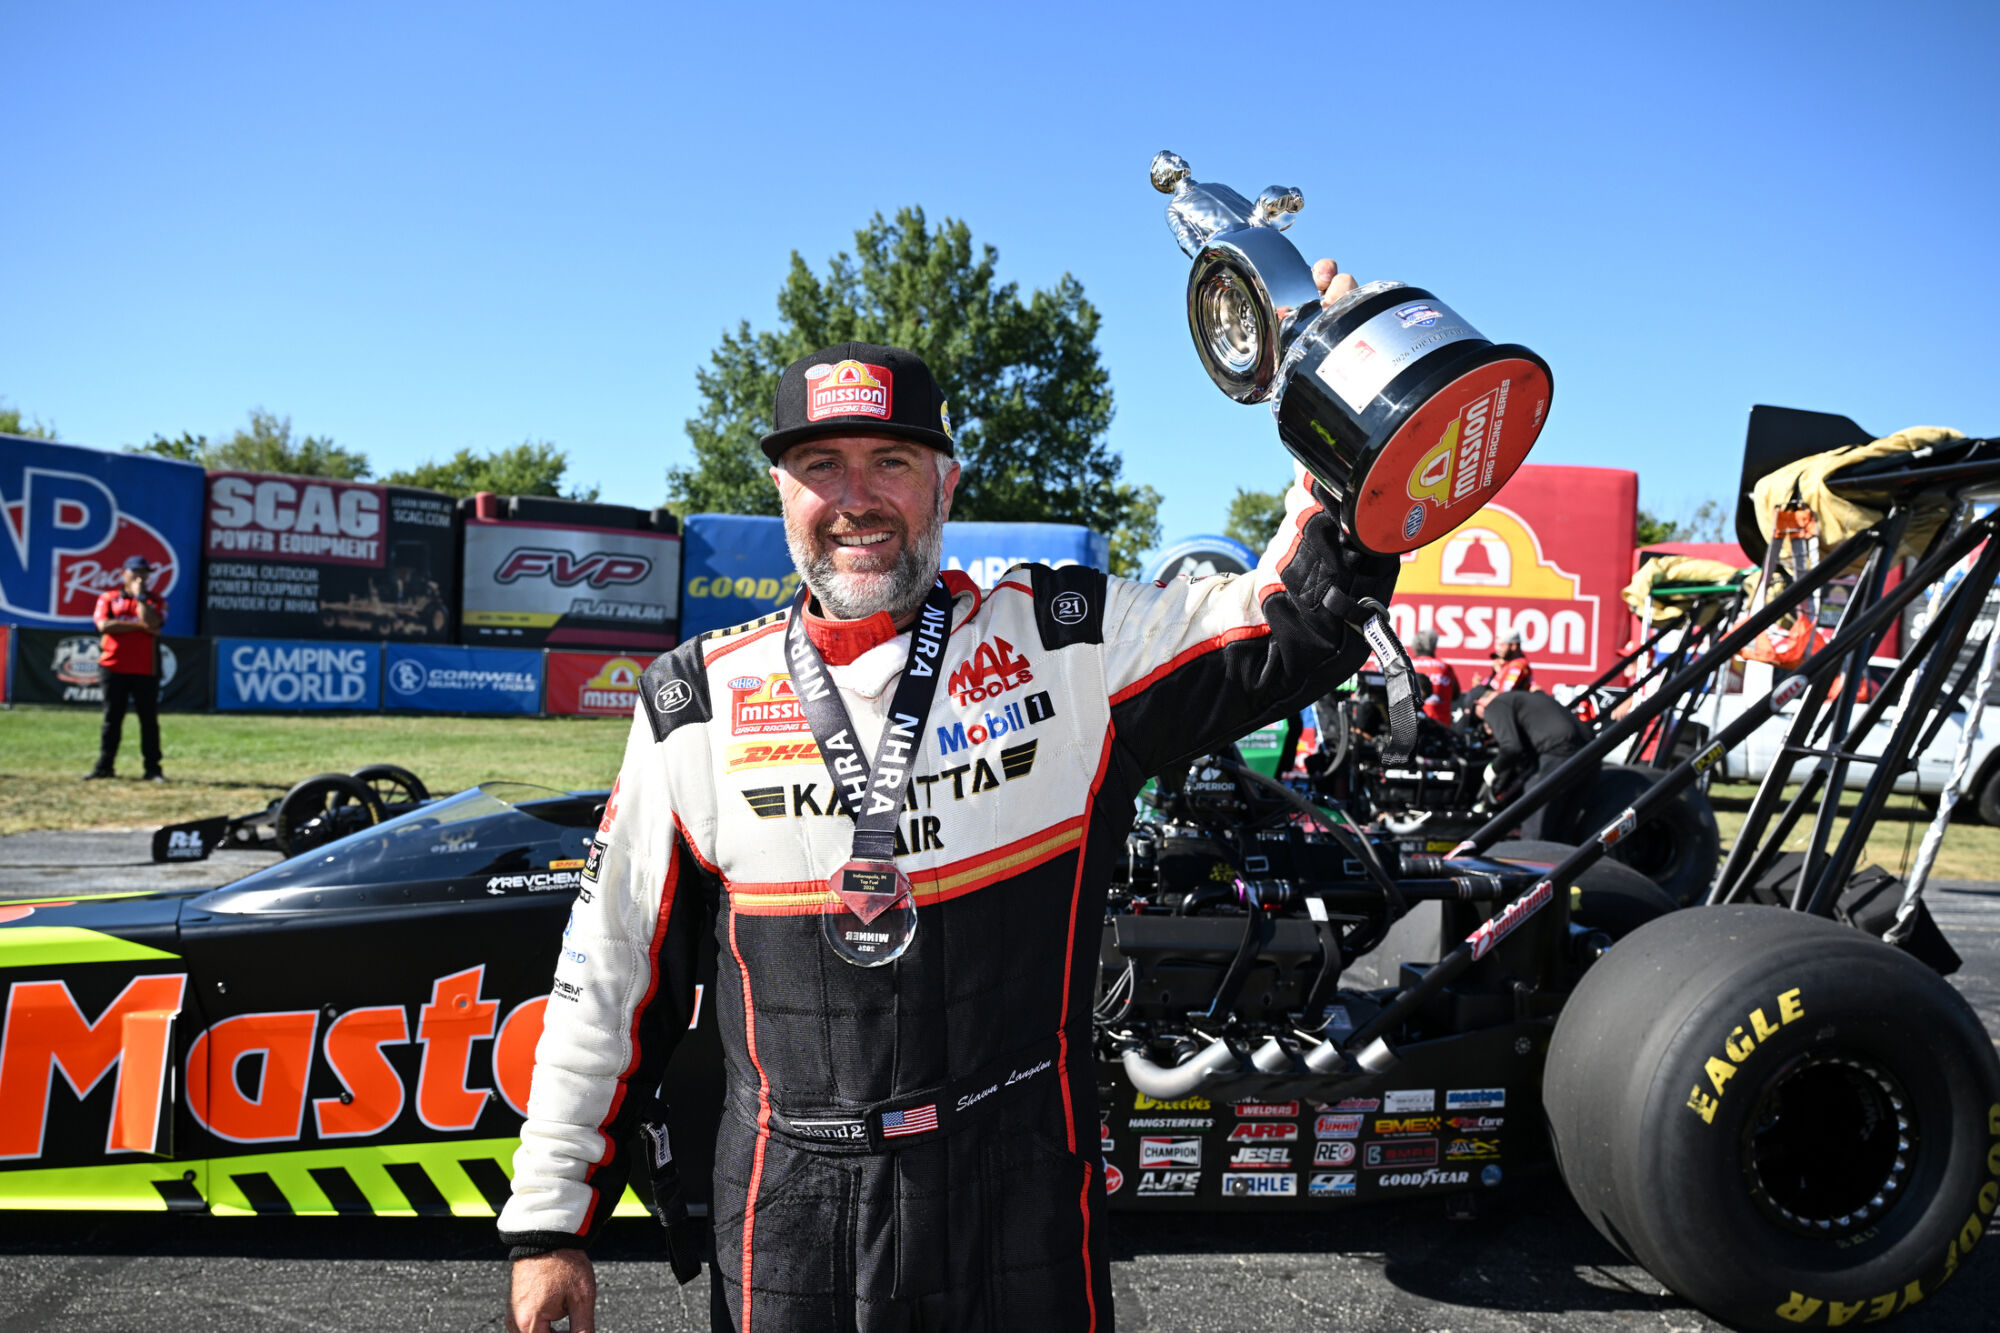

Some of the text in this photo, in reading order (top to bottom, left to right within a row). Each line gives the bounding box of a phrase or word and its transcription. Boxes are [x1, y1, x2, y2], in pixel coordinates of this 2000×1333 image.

[1483, 378, 1511, 487] DRAG RACING SERIES
[210, 477, 381, 538] SCAG
[1406, 504, 1424, 538] NHRA
[210, 528, 379, 560] POWER EQUIPMENT
[208, 563, 320, 581] OFFICIAL OUTDOOR
[495, 547, 652, 588] FVP
[64, 560, 176, 604] Racg
[208, 580, 320, 598] POWER EQUIPMENT
[207, 594, 266, 611] PROVIDER
[267, 596, 282, 612] OF
[571, 599, 666, 621] PLATINUM
[1058, 600, 1081, 615] 21
[909, 603, 946, 678] NHRA
[231, 646, 367, 674] CAMPING
[789, 615, 831, 702] NHRA
[949, 635, 1031, 697] MAC
[429, 669, 534, 683] CORNWELL
[729, 678, 762, 690] NHRA
[232, 672, 367, 703] WORLD
[662, 685, 686, 704] 21
[952, 669, 1034, 707] TOOLS
[734, 726, 761, 736] DRAG
[763, 723, 799, 733] RACING
[936, 695, 1046, 757] Mobil 1
[742, 743, 823, 765] DHL
[865, 711, 920, 817] NHRA
[825, 729, 869, 814] HRA
[1191, 781, 1236, 792] UPERIOR
[500, 871, 580, 889] REVCHEM
[1686, 987, 1805, 1125] EAGLE
[955, 1059, 1052, 1113] Shawn Langdon
[1242, 1105, 1293, 1115] WELDERS
[1128, 1118, 1214, 1129] HANGSTERFER'S
[1231, 1124, 1297, 1139] ARP
[1143, 1146, 1198, 1158] CHAMPION
[1230, 1147, 1293, 1164] JESEL
[1378, 1168, 1470, 1189] GOODYEAR
